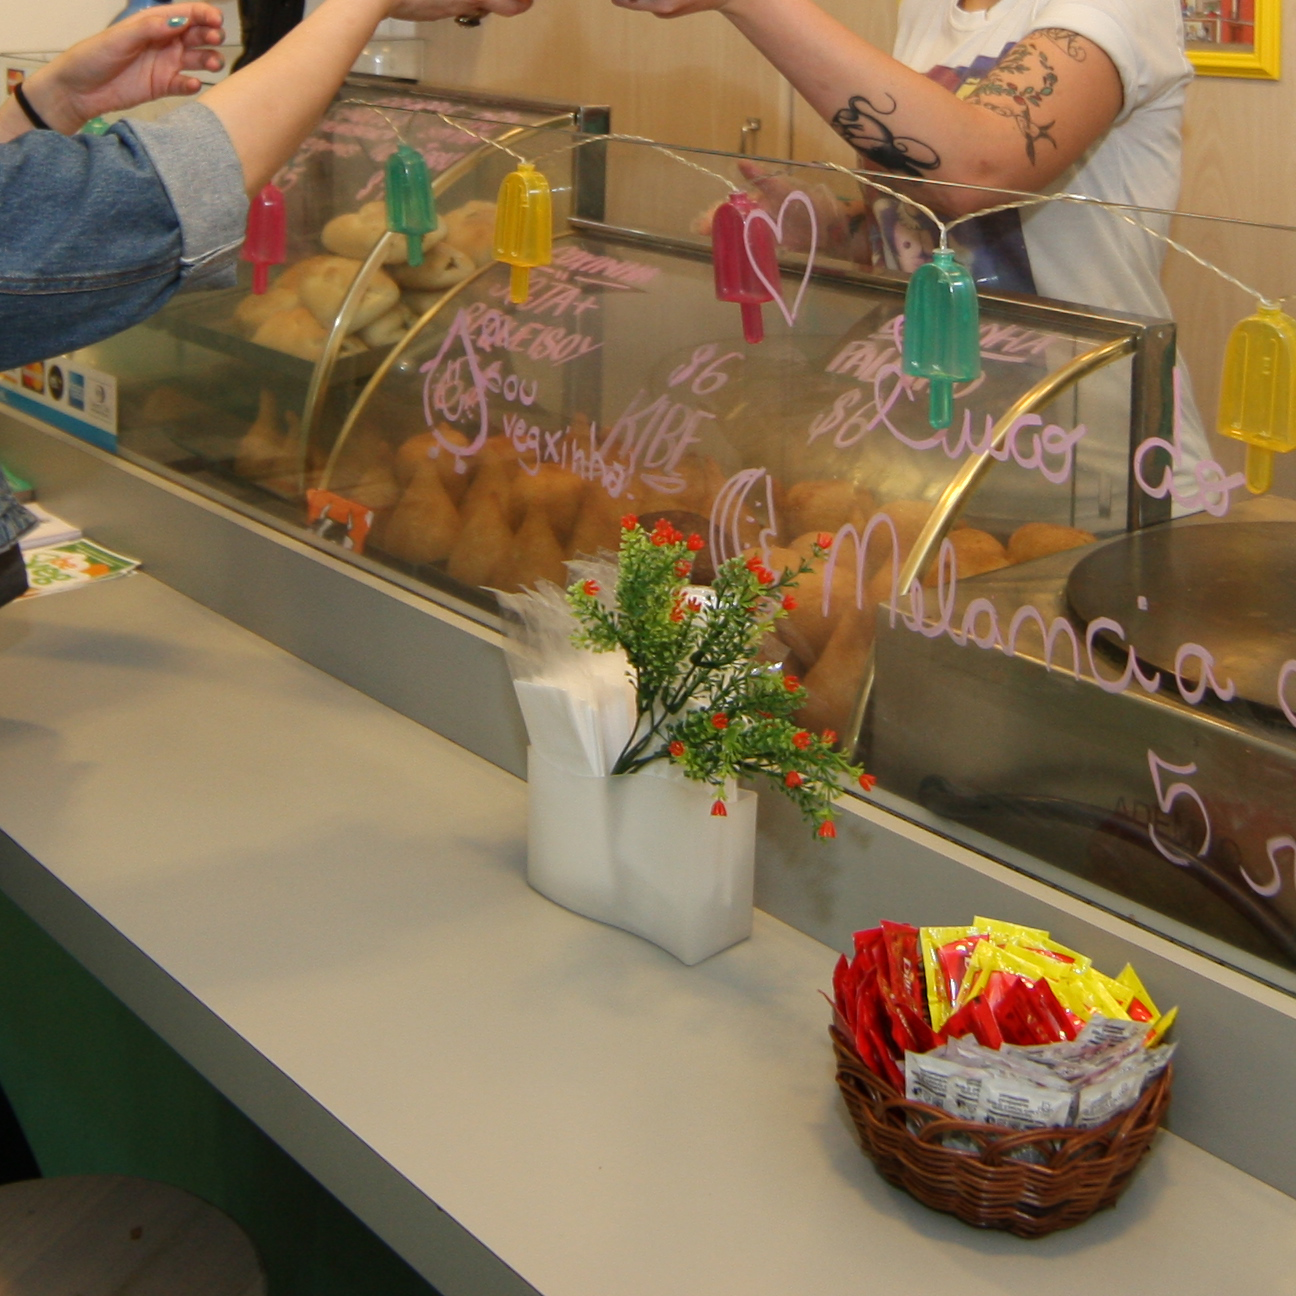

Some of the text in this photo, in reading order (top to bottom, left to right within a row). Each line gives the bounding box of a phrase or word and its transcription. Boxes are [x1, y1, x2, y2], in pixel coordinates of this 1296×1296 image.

[601, 388, 716, 480] KIBE
[1134, 366, 1245, 516] do
[822, 512, 1236, 704] Melancia
[1147, 748, 1211, 867] 5
